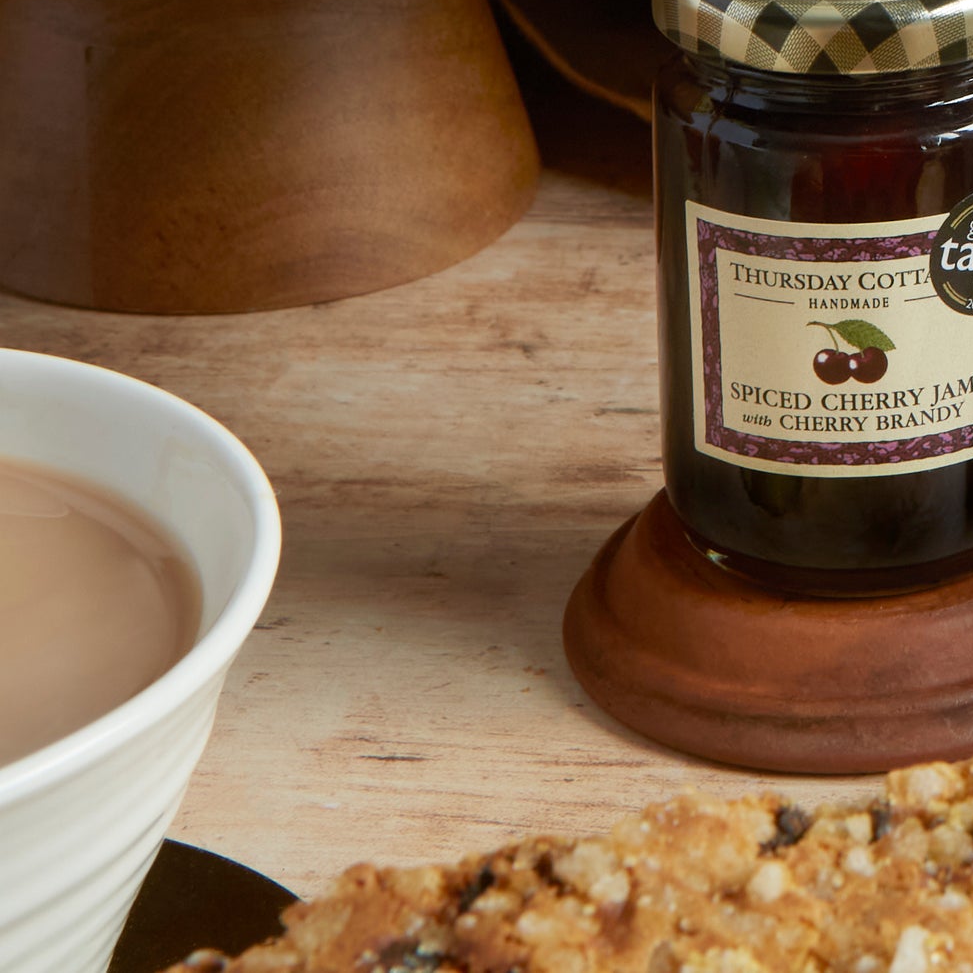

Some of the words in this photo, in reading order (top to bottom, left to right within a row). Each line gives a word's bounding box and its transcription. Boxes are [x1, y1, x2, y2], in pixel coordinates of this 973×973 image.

[730, 262, 851, 291] THURSDAY
[809, 297, 890, 310] HANDMADE
[730, 382, 811, 410] SPICED
[821, 388, 924, 411] CHERRY
[742, 413, 773, 427] with
[779, 414, 868, 432] CHERRY
[876, 401, 965, 431] BRANDY
